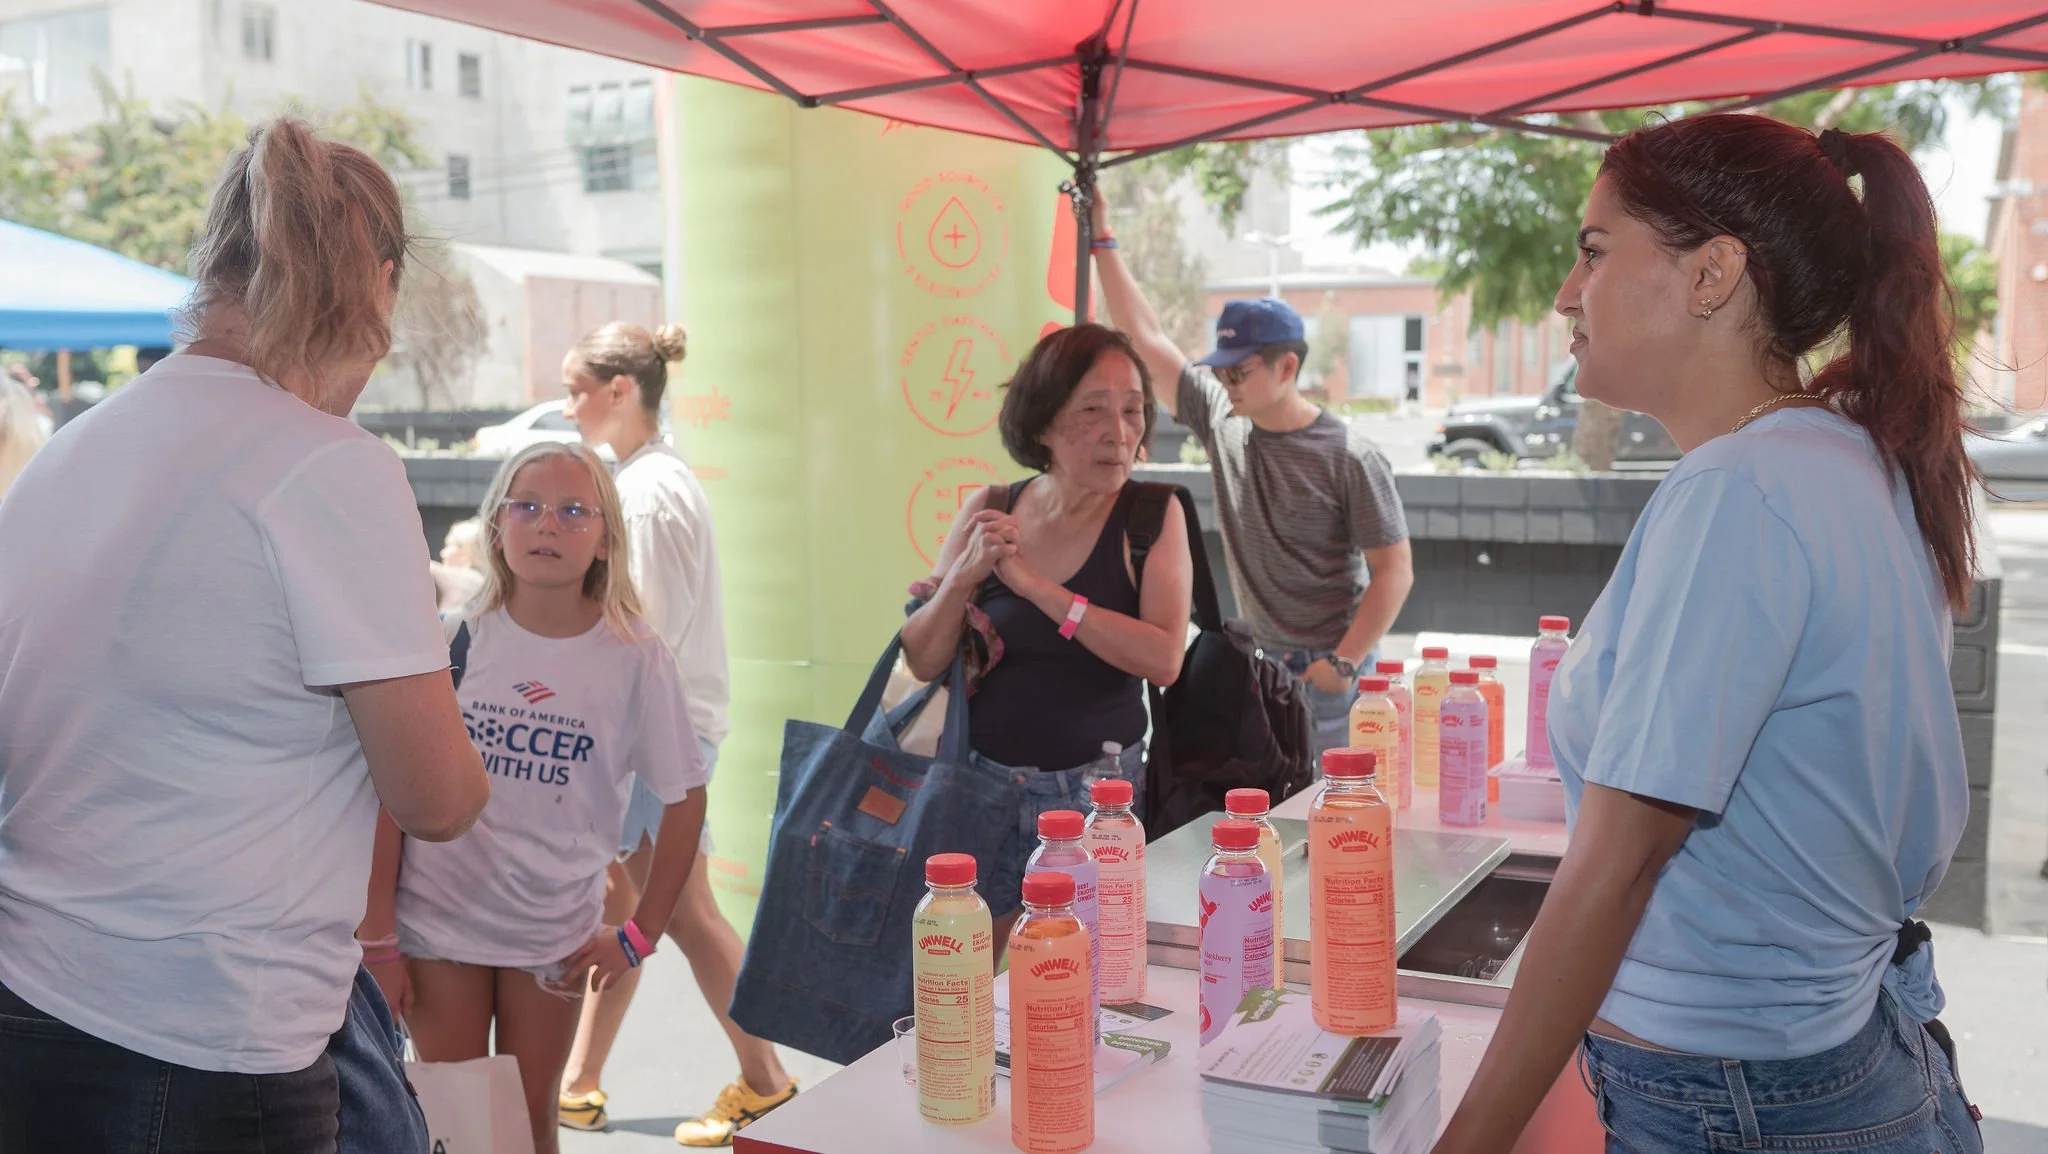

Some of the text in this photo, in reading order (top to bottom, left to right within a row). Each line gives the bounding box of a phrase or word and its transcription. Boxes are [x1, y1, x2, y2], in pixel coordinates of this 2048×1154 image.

[472, 700, 586, 729] BANK OF AMERICA
[462, 711, 595, 762] SOCCER
[538, 763, 570, 786] US
[1328, 830, 1380, 850] UNWELL
[1122, 896, 1132, 904] 25
[1248, 890, 1272, 911] UNW
[918, 934, 964, 954] UNWELL
[1031, 958, 1081, 978] UNWELL
[946, 979, 969, 987] Facts
[956, 995, 969, 1004] 25
[1027, 1004, 1062, 1013] Nutrition
